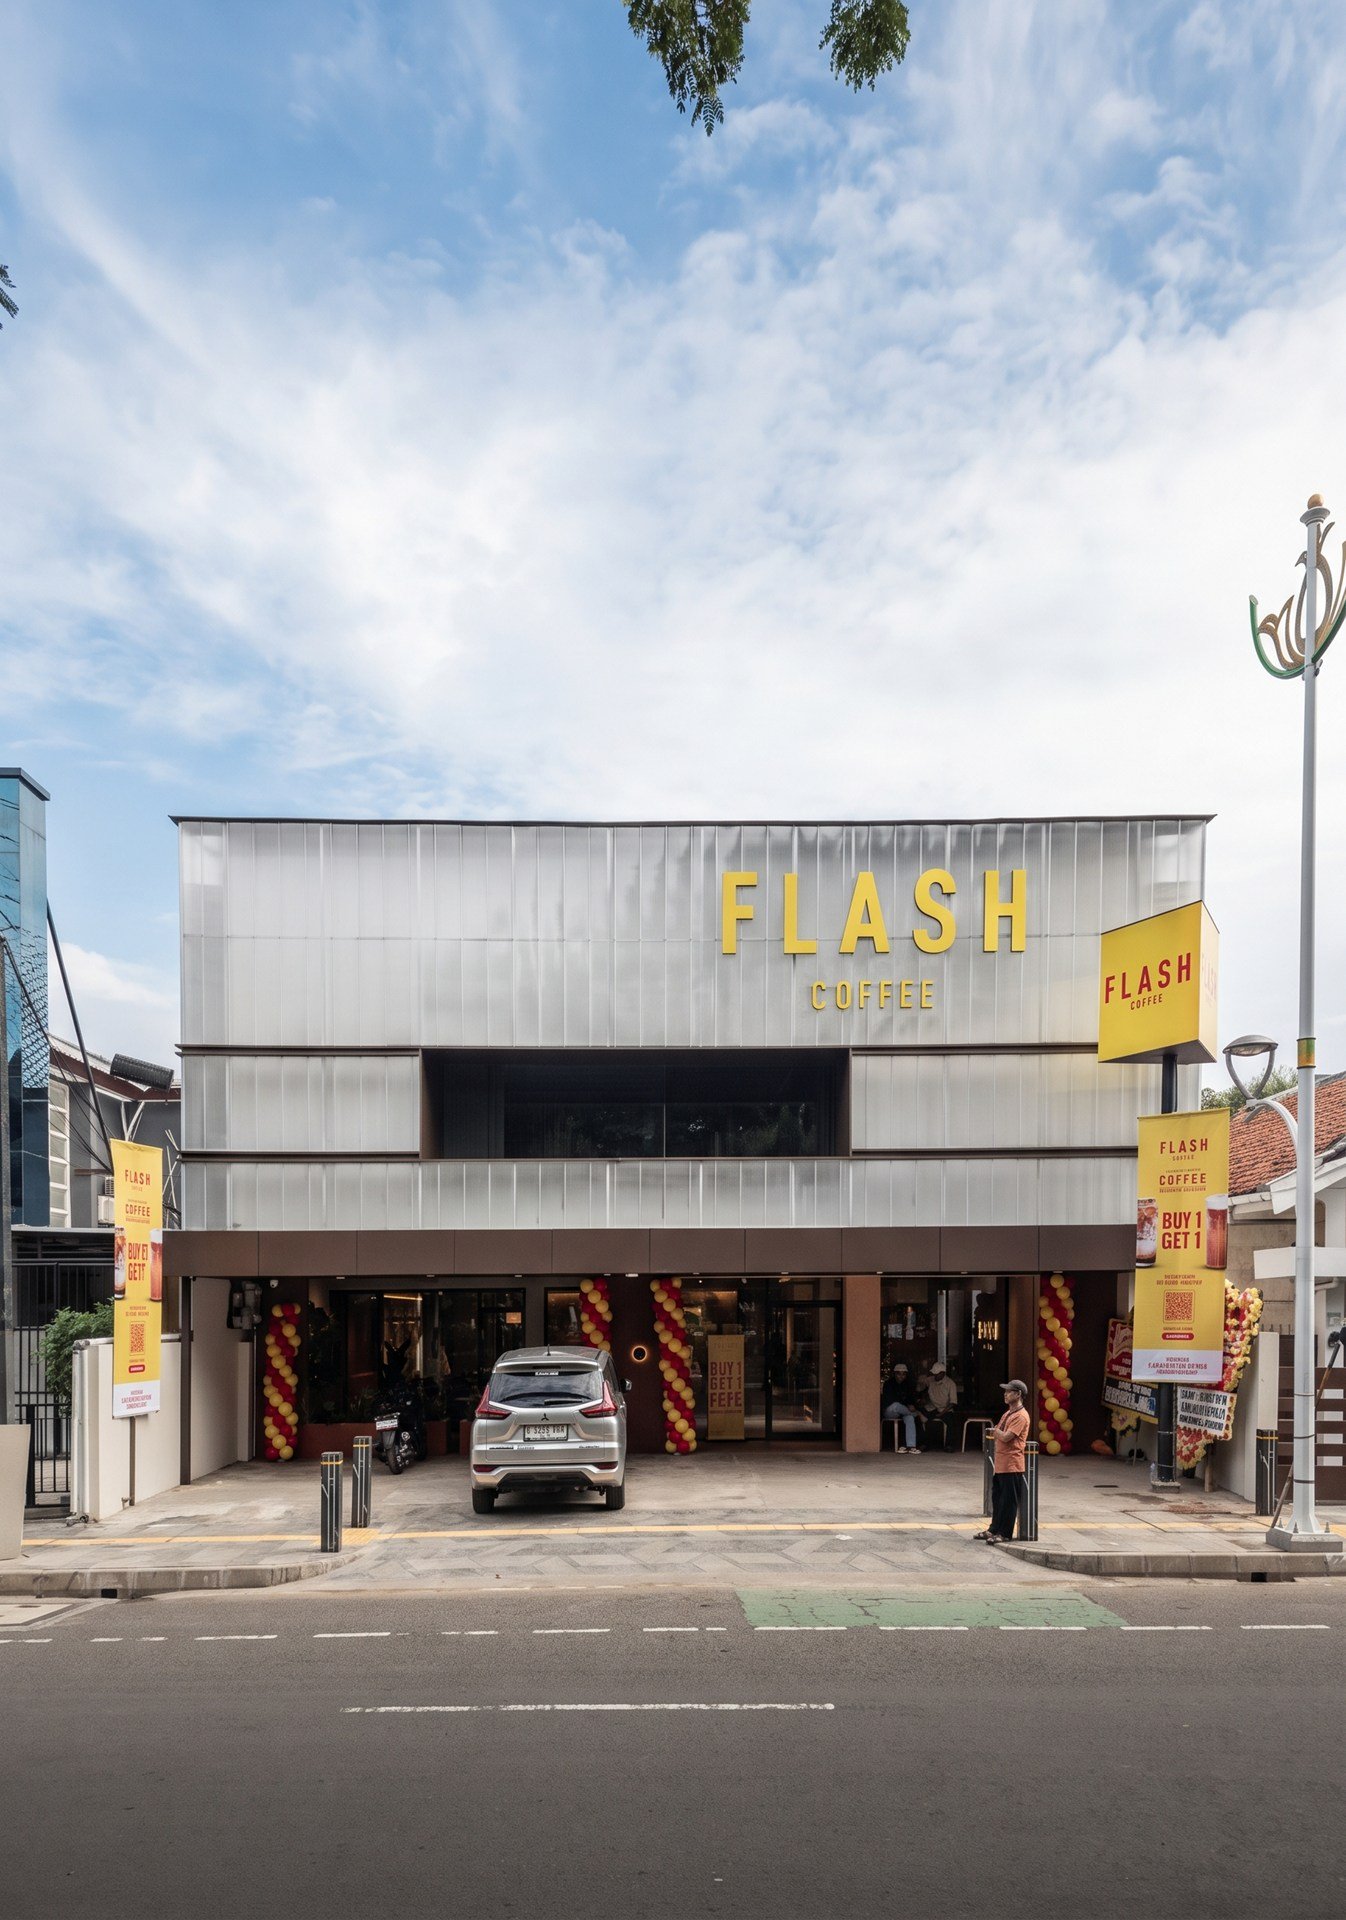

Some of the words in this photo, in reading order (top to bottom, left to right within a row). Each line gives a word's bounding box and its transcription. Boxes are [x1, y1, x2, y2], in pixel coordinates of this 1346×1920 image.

[722, 868, 1027, 954] FLASH
[1105, 952, 1191, 1004] FLASH
[811, 979, 934, 1010] COFFEE
[1130, 993, 1163, 1011] COFFEE
[1160, 1138, 1208, 1154] FLASH
[124, 1169, 151, 1186] FLASH
[1159, 1173, 1207, 1186] COFFEE
[125, 1203, 151, 1217] COFFEE
[1162, 1211, 1192, 1229] BUY
[1195, 1211, 1202, 1229] 1
[1161, 1231, 1190, 1250] GET
[1194, 1231, 1201, 1249] 1
[128, 1242, 141, 1260] BUY
[710, 1361, 734, 1376] BUY
[736, 1361, 742, 1376] 1
[710, 1377, 733, 1390] GET
[736, 1376, 742, 1390] 1
